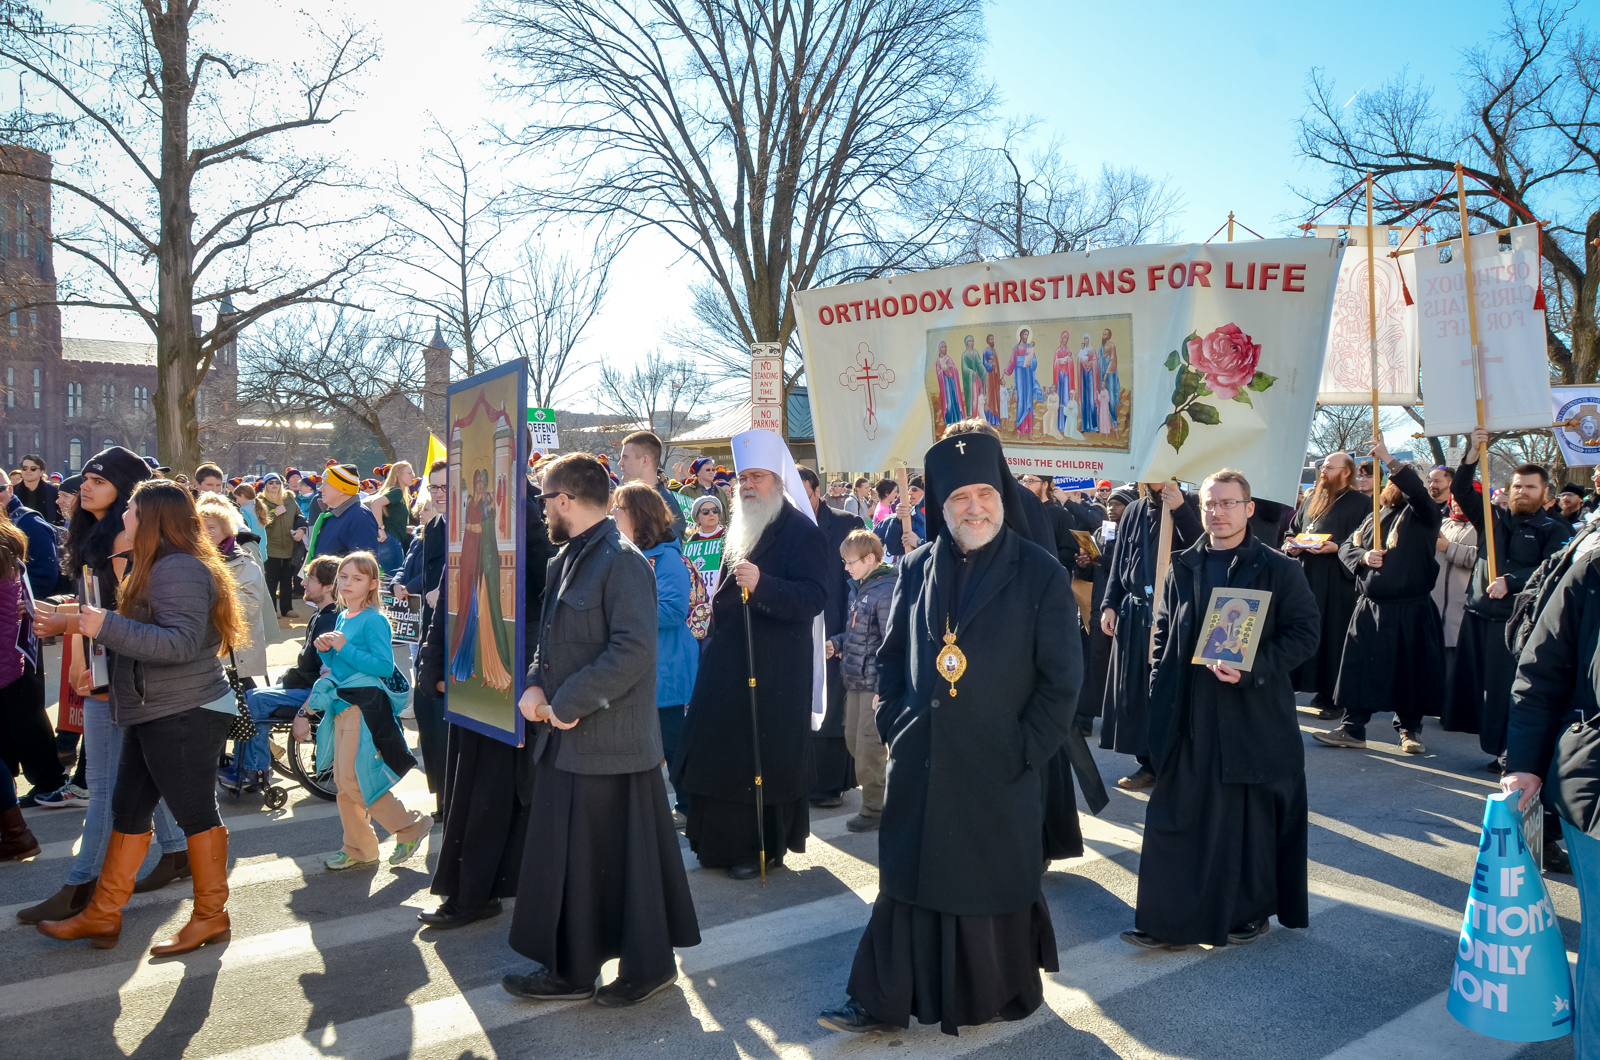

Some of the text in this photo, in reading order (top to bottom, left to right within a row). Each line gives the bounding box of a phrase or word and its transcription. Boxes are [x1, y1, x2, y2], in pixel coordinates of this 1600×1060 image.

[818, 287, 954, 325] ORTHODOX
[962, 267, 1136, 307] CHRISTIANS
[1147, 260, 1212, 292] FOR
[1225, 261, 1306, 293] LIFE
[760, 361, 772, 371] NO
[754, 372, 778, 380] STANDING
[760, 409, 772, 419] NO
[528, 423, 556, 433] DEFEND
[753, 419, 779, 428] PARKING
[536, 434, 552, 444] LIFE
[1034, 459, 1053, 468] THE
[1055, 460, 1104, 470] CHILDREN
[683, 540, 721, 557] LOVE LIFE
[393, 596, 409, 608] Pro
[386, 605, 420, 622] bundant
[1500, 865, 1526, 897] IF
[1464, 896, 1553, 937] TION'S
[1458, 929, 1533, 976] ONLY
[1451, 961, 1508, 1013] ION
